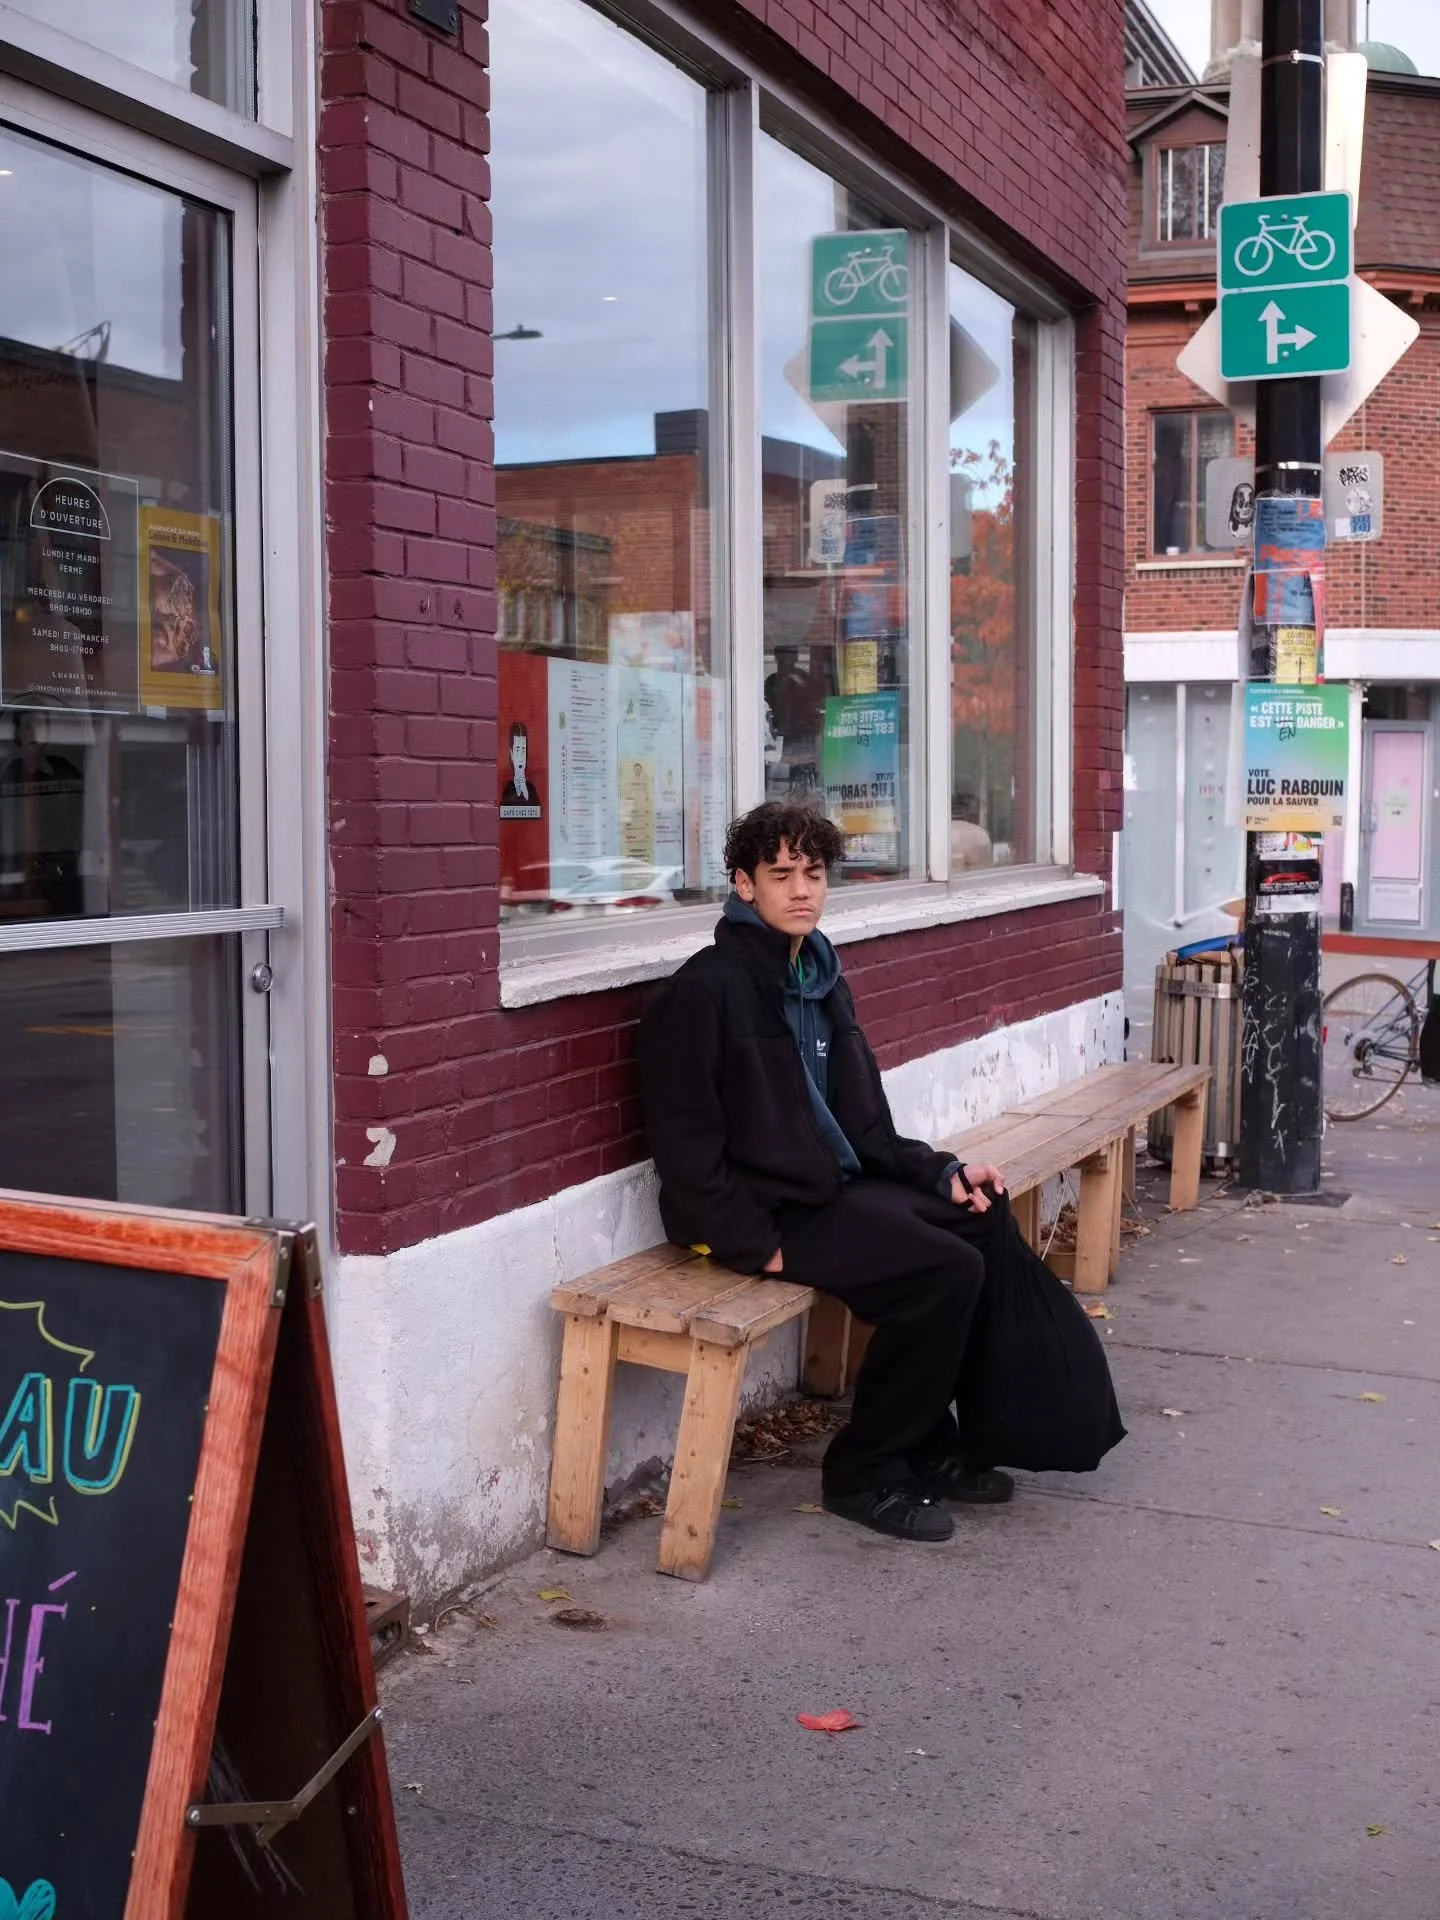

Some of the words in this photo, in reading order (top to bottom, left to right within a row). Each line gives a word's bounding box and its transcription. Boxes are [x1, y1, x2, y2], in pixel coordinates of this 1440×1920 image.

[55, 494, 90, 509] HEURES
[40, 510, 103, 529] D'OUVERTURE
[42, 548, 64, 559] LUNDI
[66, 552, 75, 560] ET
[77, 554, 99, 564] MARDI
[28, 587, 65, 598] MERCREDI
[79, 594, 113, 605] VENDREDI
[32, 628, 60, 638] SAMEDI
[63, 631, 71, 640] ET
[73, 632, 110, 644] DIMANCHE
[1261, 702, 1293, 715] CETTE
[1296, 702, 1323, 715] PISTE
[1249, 716, 1272, 729] EST
[1276, 717, 1293, 728] UN
[1296, 717, 1336, 729] DANGER
[1279, 727, 1296, 741] EN
[1248, 769, 1270, 777] VOTE
[1247, 779, 1276, 795] LUC
[1281, 780, 1344, 796] RABOUIN
[1247, 797, 1270, 805] POUR
[1272, 797, 1283, 805] LA
[1286, 797, 1319, 806] SAUVER
